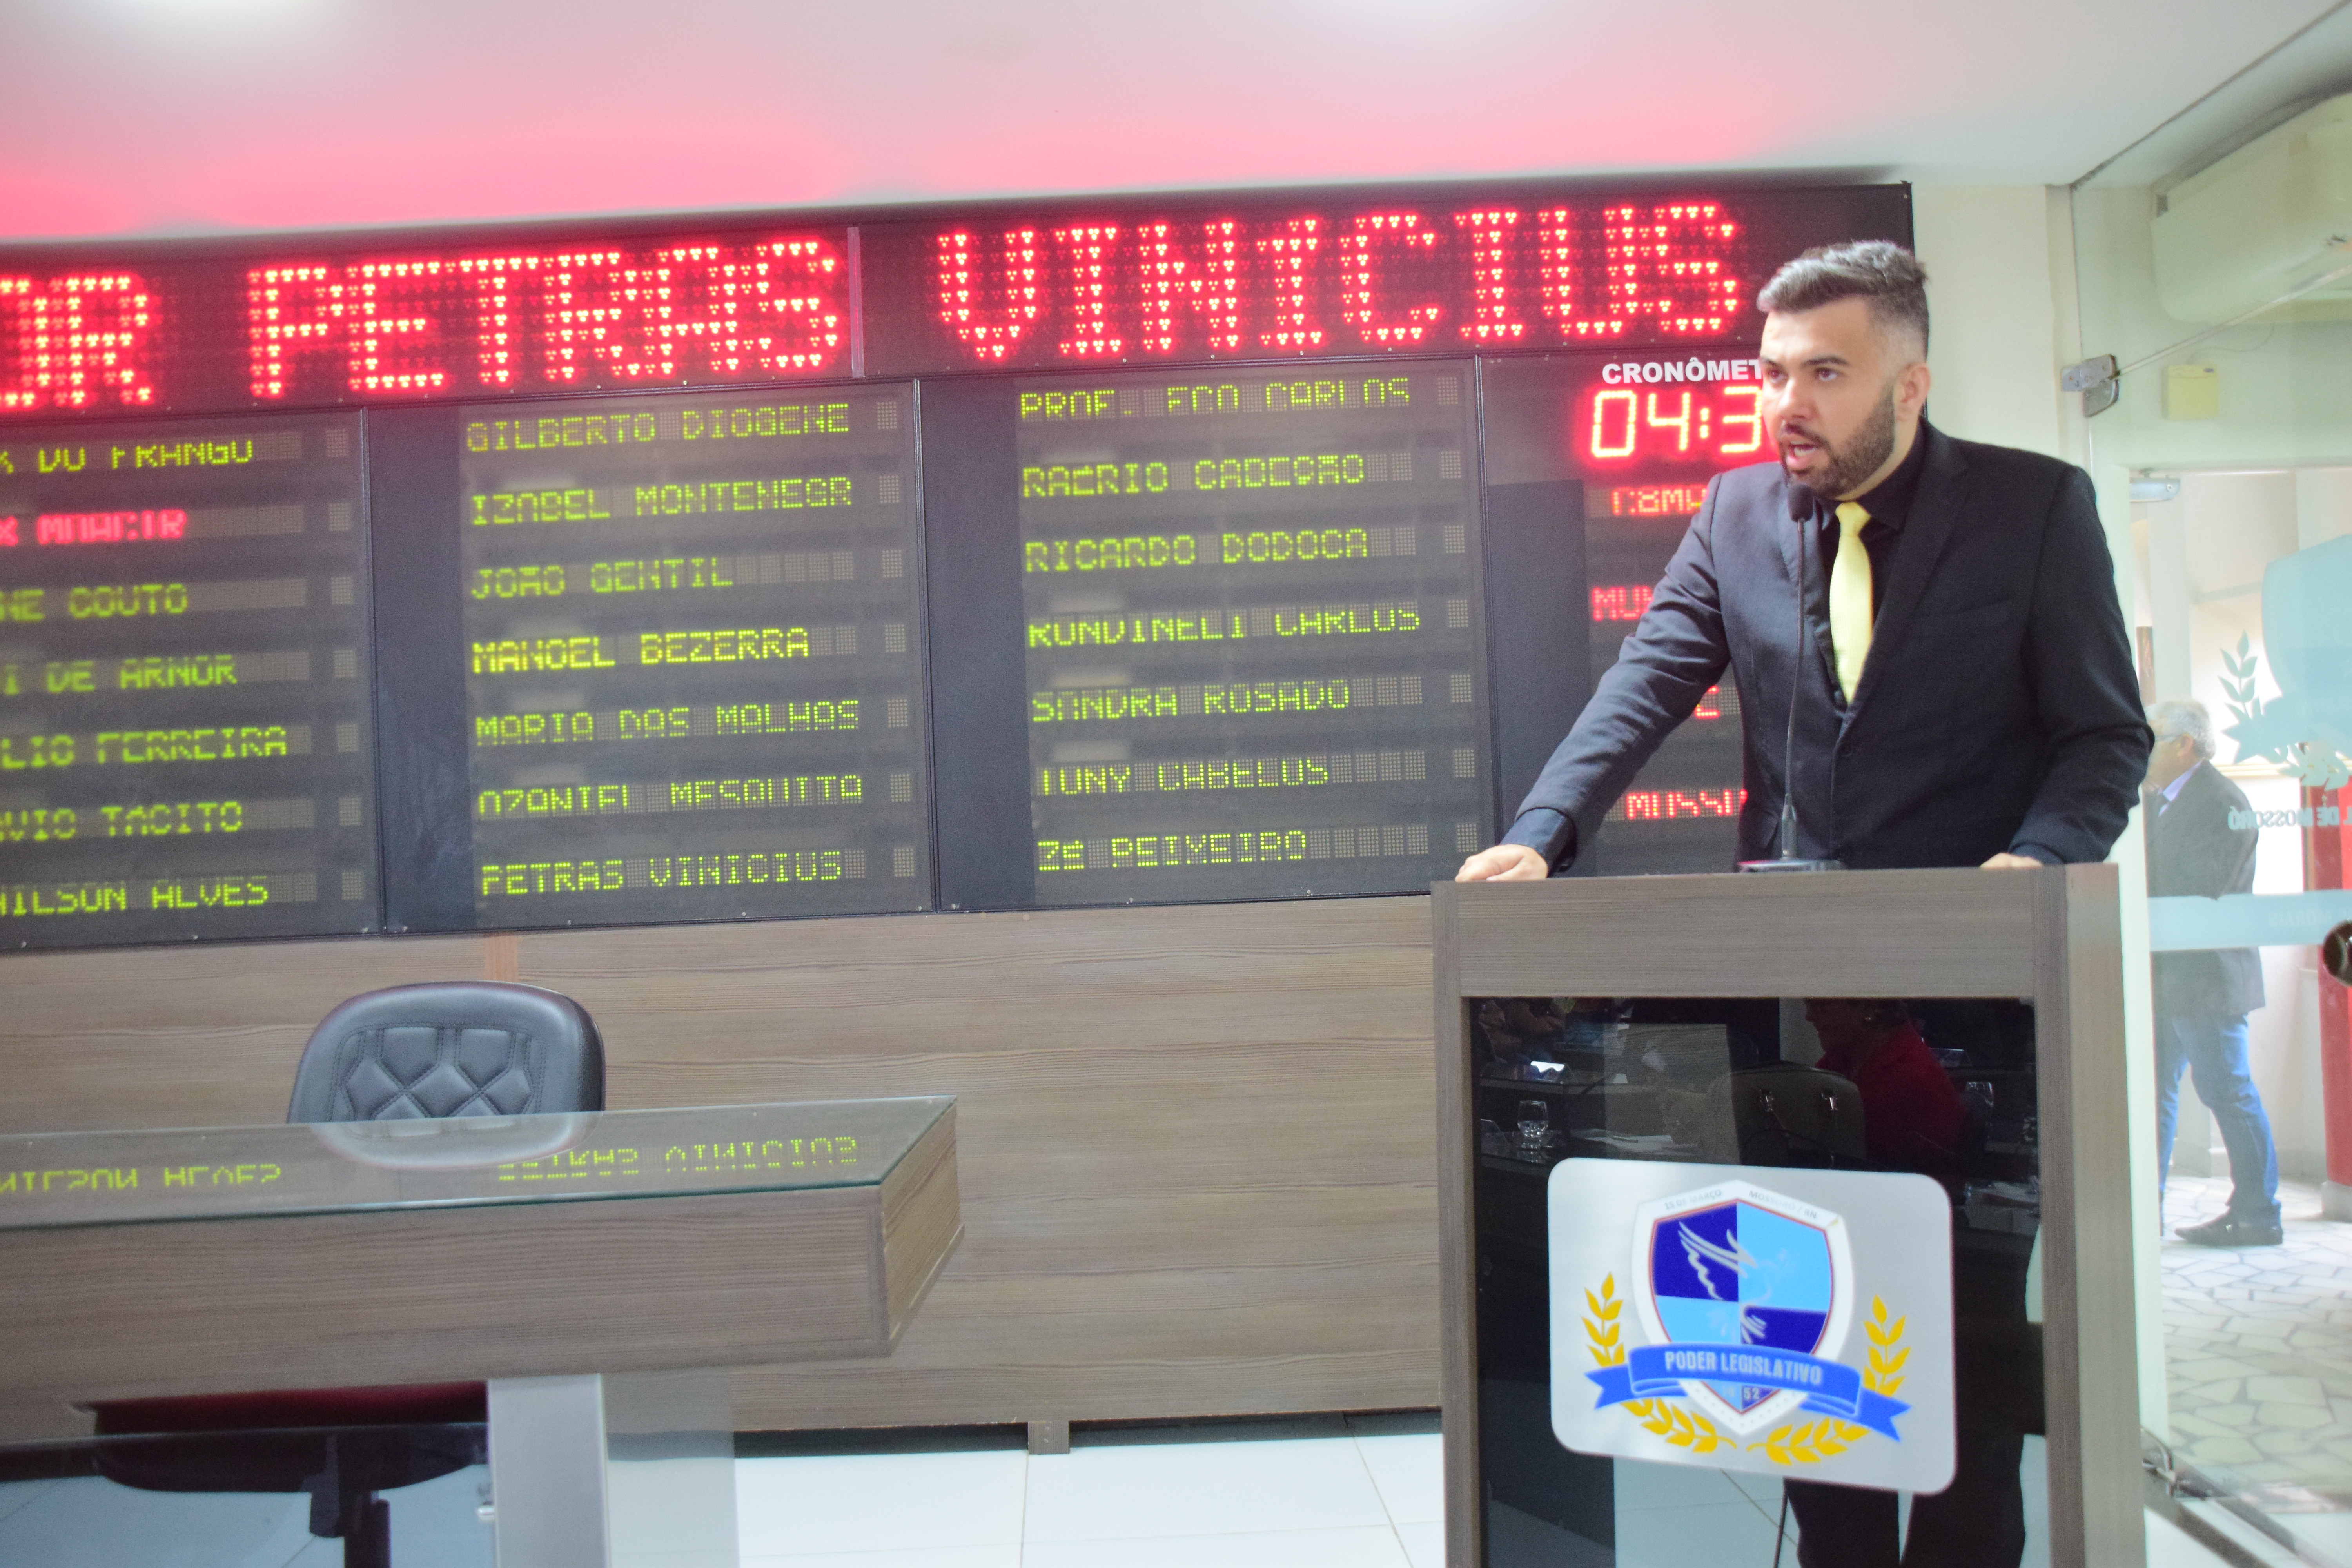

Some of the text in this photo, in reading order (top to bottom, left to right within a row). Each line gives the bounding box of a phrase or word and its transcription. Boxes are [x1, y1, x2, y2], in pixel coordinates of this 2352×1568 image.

[247, 239, 842, 400] PETRAS
[937, 204, 1738, 358] VINICIUS
[469, 403, 849, 452] GILBERTO DIOGENE
[1025, 535, 1196, 572] RICARDO
[472, 627, 810, 674] MANOEL BEZERRA
[481, 851, 841, 896] PETRAS VINICIUS
[1804, 1208, 1818, 1220] RN
[1665, 1350, 1823, 1385] PODER LEGISLATIVO
